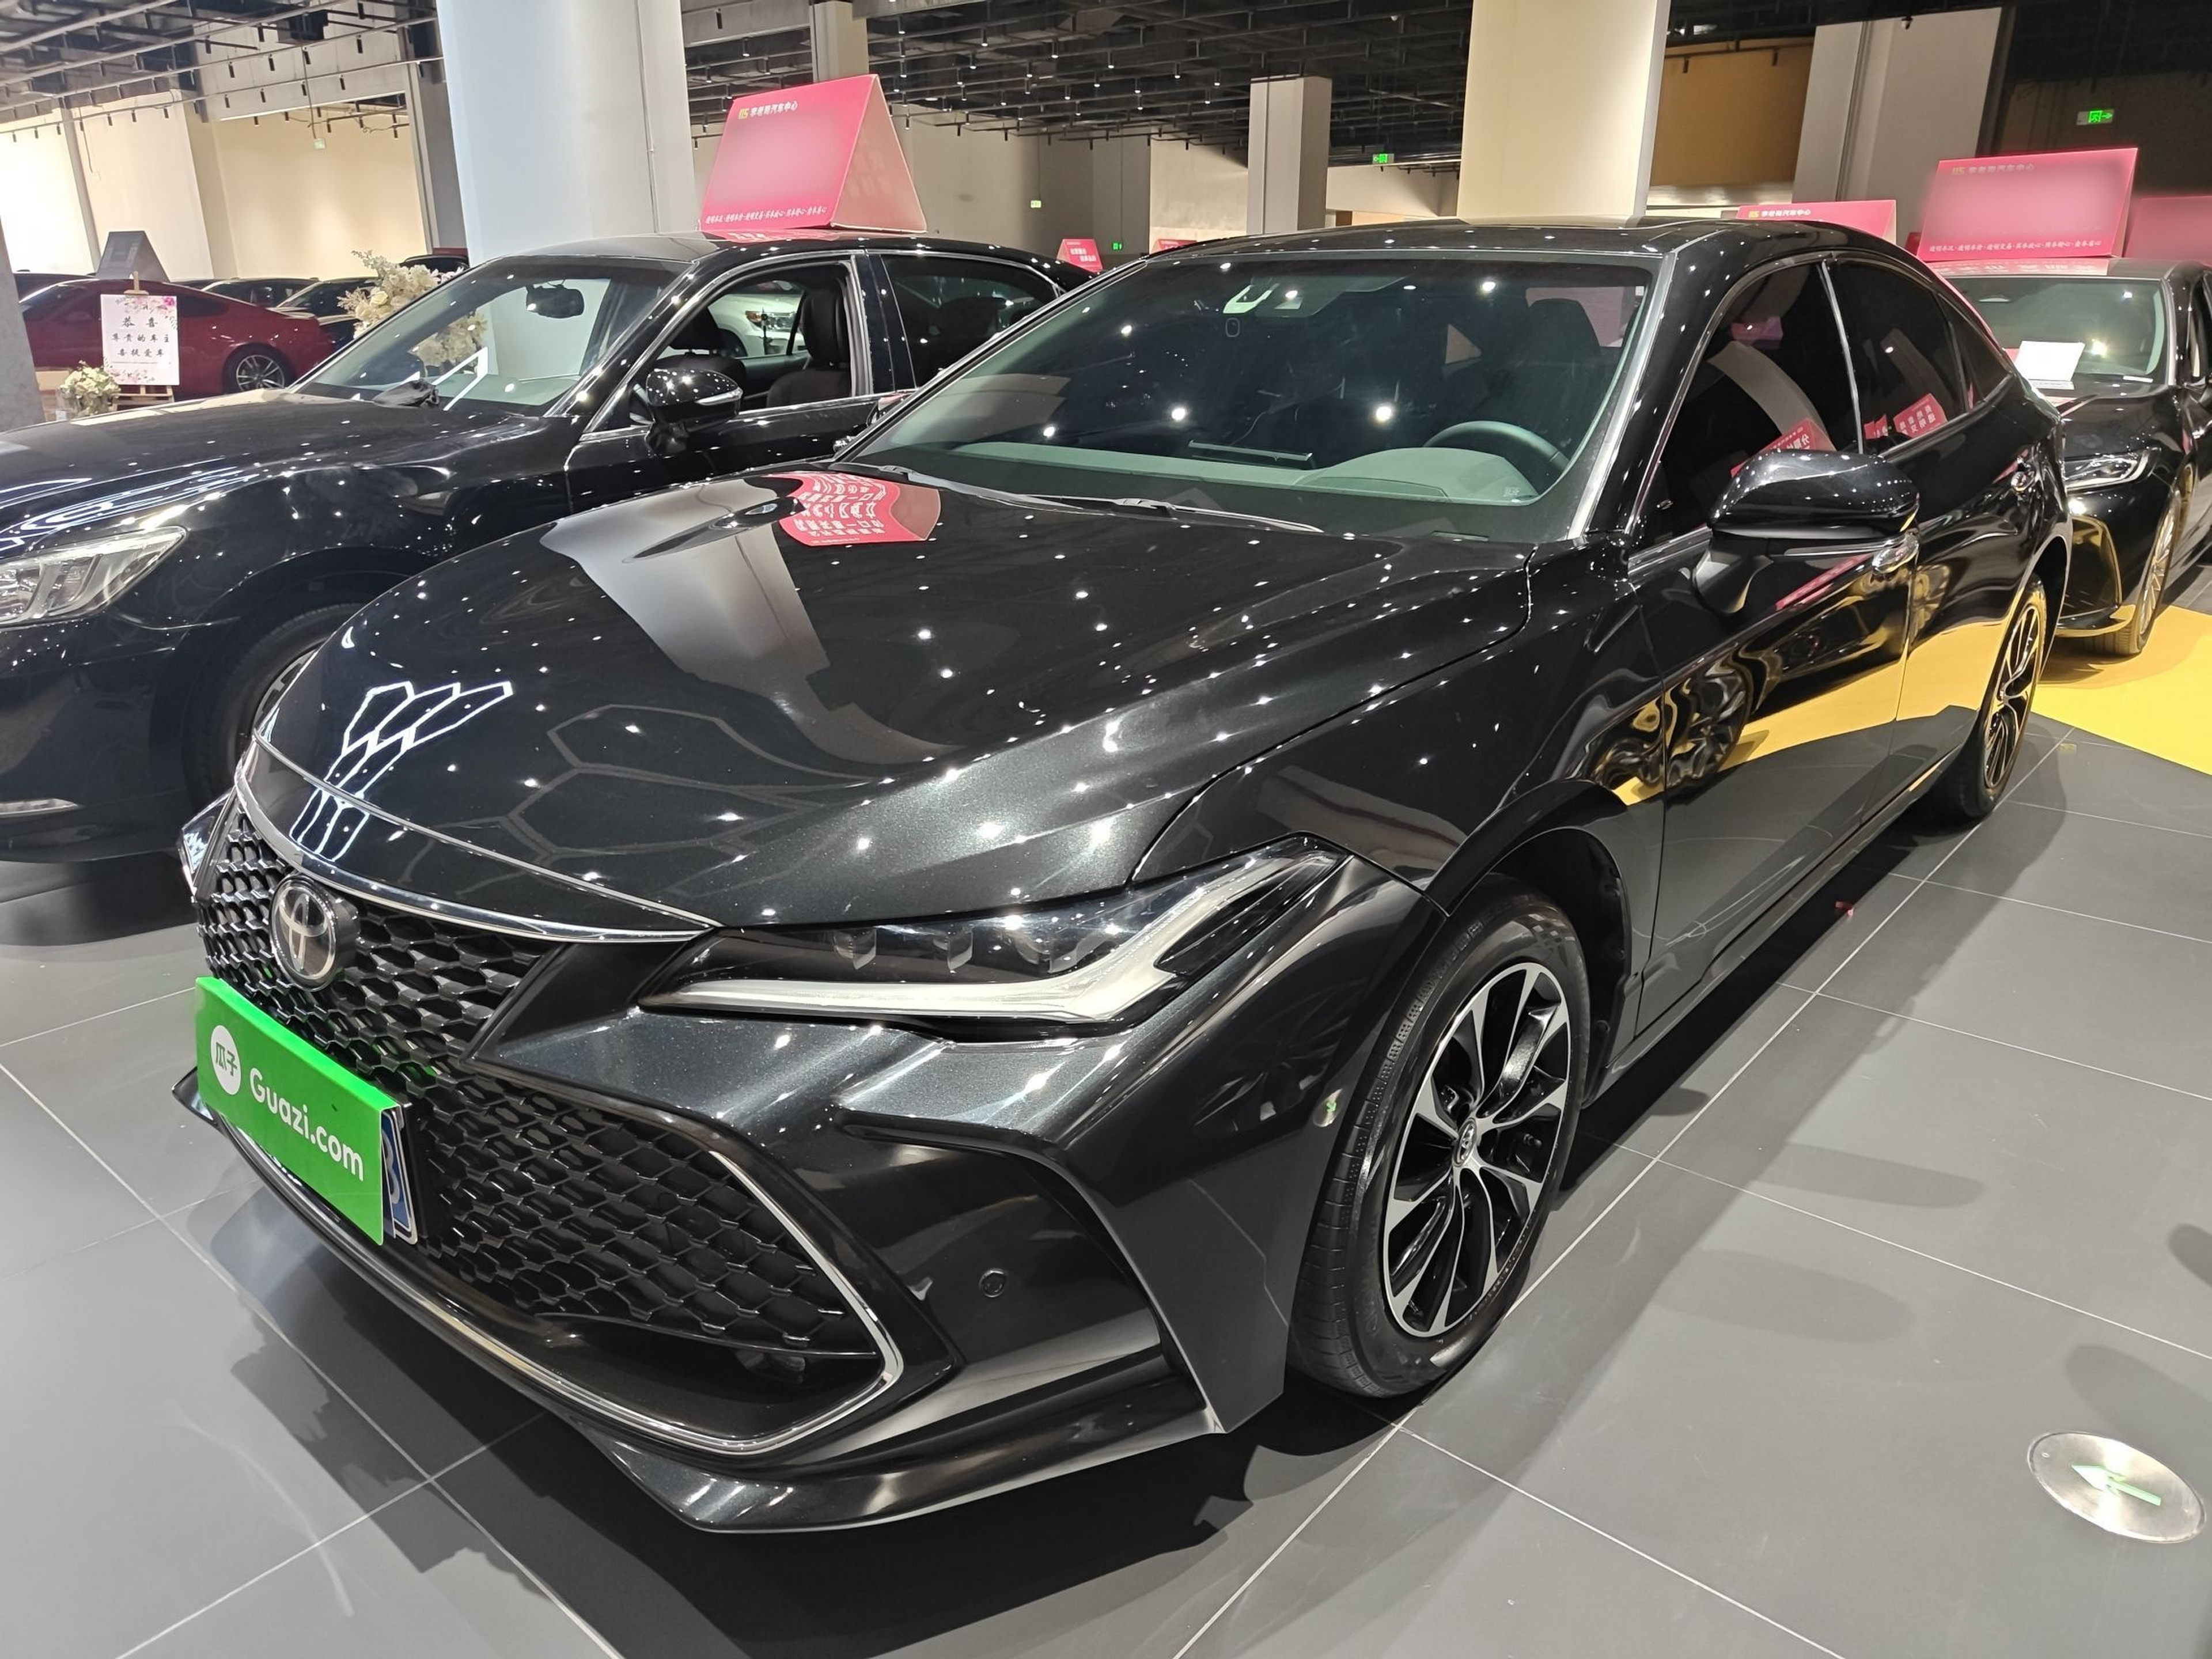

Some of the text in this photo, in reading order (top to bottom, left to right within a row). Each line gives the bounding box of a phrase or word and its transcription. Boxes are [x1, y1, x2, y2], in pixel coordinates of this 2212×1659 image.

[122, 316, 158, 328] 恭喜
[111, 332, 169, 343] 尊贵的车主
[118, 349, 164, 357] 喜提爱车
[215, 1041, 237, 1077] 瓜子
[250, 1067, 363, 1181] Guazi.com
